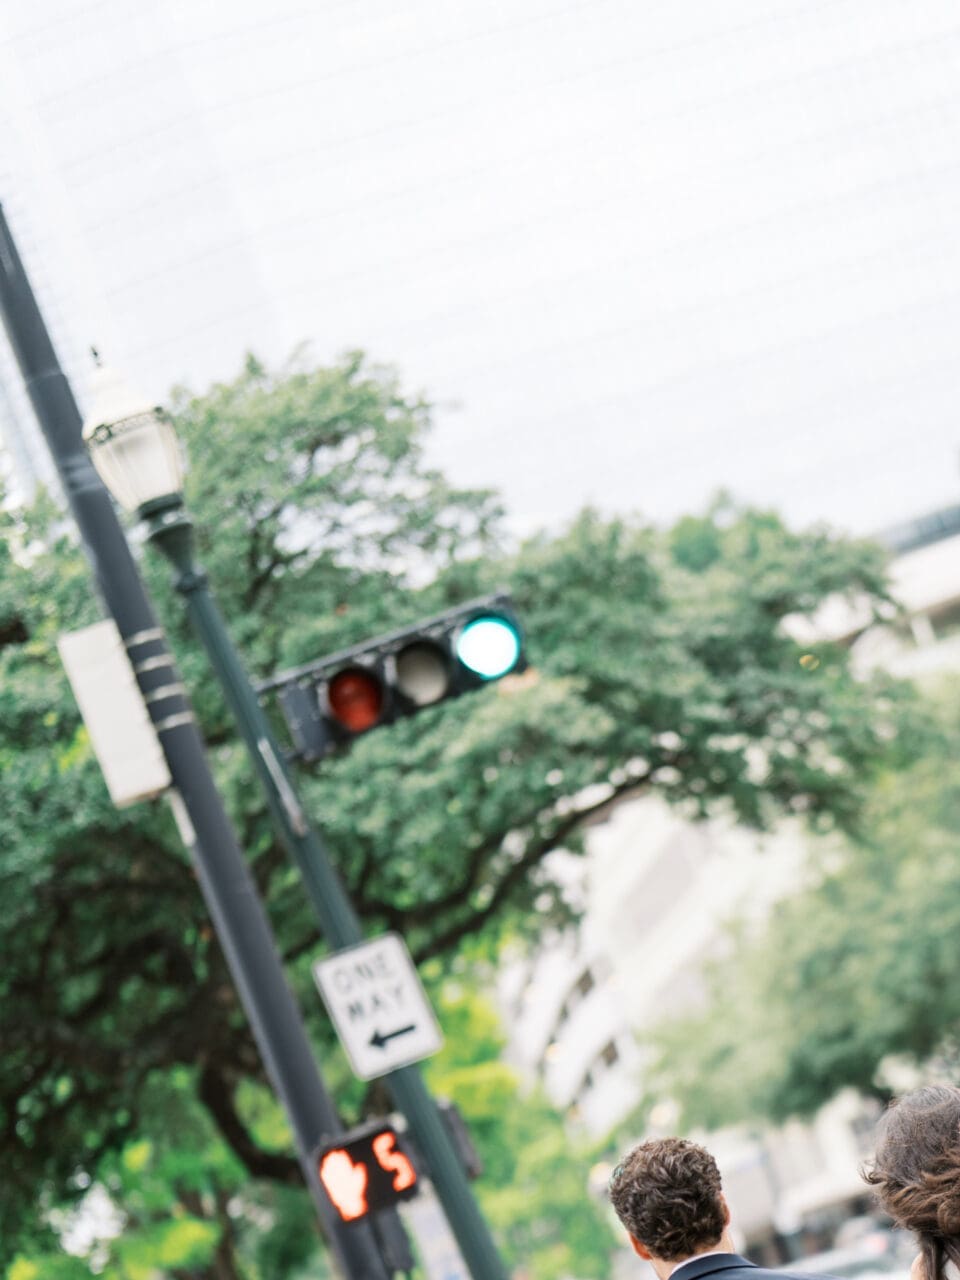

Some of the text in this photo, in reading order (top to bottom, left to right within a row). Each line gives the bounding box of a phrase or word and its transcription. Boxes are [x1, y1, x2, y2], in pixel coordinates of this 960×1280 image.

[332, 951, 395, 995] ONE
[346, 981, 405, 1024] WAY
[372, 1131, 417, 1192] 5
